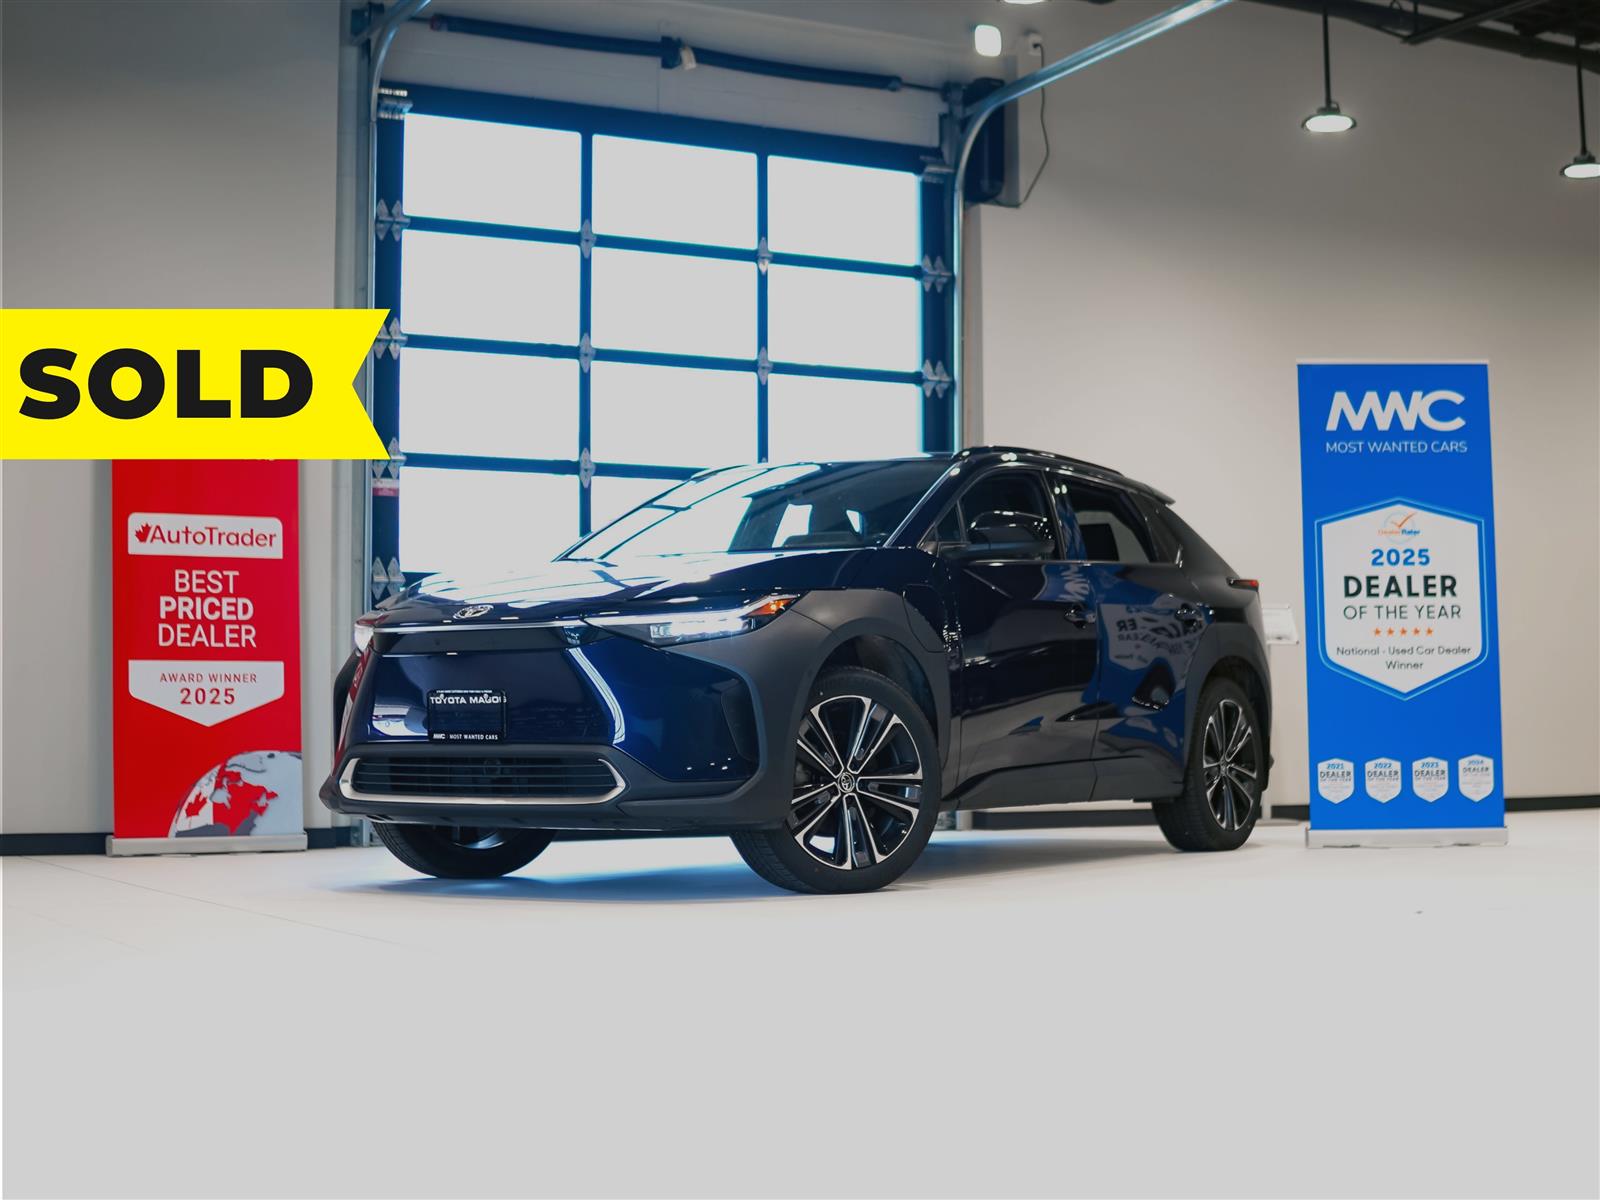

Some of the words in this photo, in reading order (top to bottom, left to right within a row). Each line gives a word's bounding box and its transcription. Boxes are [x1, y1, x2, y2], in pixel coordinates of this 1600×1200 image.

[1326, 390, 1466, 431] MWC
[1326, 441, 1364, 454] MOST
[1368, 441, 1428, 454] WANTED
[1431, 441, 1468, 454] CARS
[150, 525, 277, 548] AutoTrader
[1371, 548, 1431, 567] 2025
[174, 569, 240, 594] BEST
[1343, 575, 1458, 599] DEALER
[159, 595, 254, 621] PRICED
[1343, 605, 1368, 621] OF
[1374, 605, 1408, 620] THE
[1414, 604, 1462, 620] YEAR
[158, 623, 257, 648] DEALER
[1336, 646, 1380, 656] National
[1388, 646, 1414, 656] Used
[1416, 646, 1435, 656] Car
[1437, 645, 1471, 656] Dealer
[1386, 660, 1424, 671] Winner
[160, 673, 203, 683] AWARD
[208, 673, 257, 683] WINNER
[180, 688, 235, 705] 2025
[430, 696, 467, 704] TOYOTA
[1319, 770, 1351, 779] DEALER
[1367, 770, 1399, 778] DEALER
[1414, 769, 1446, 778] DEALER
